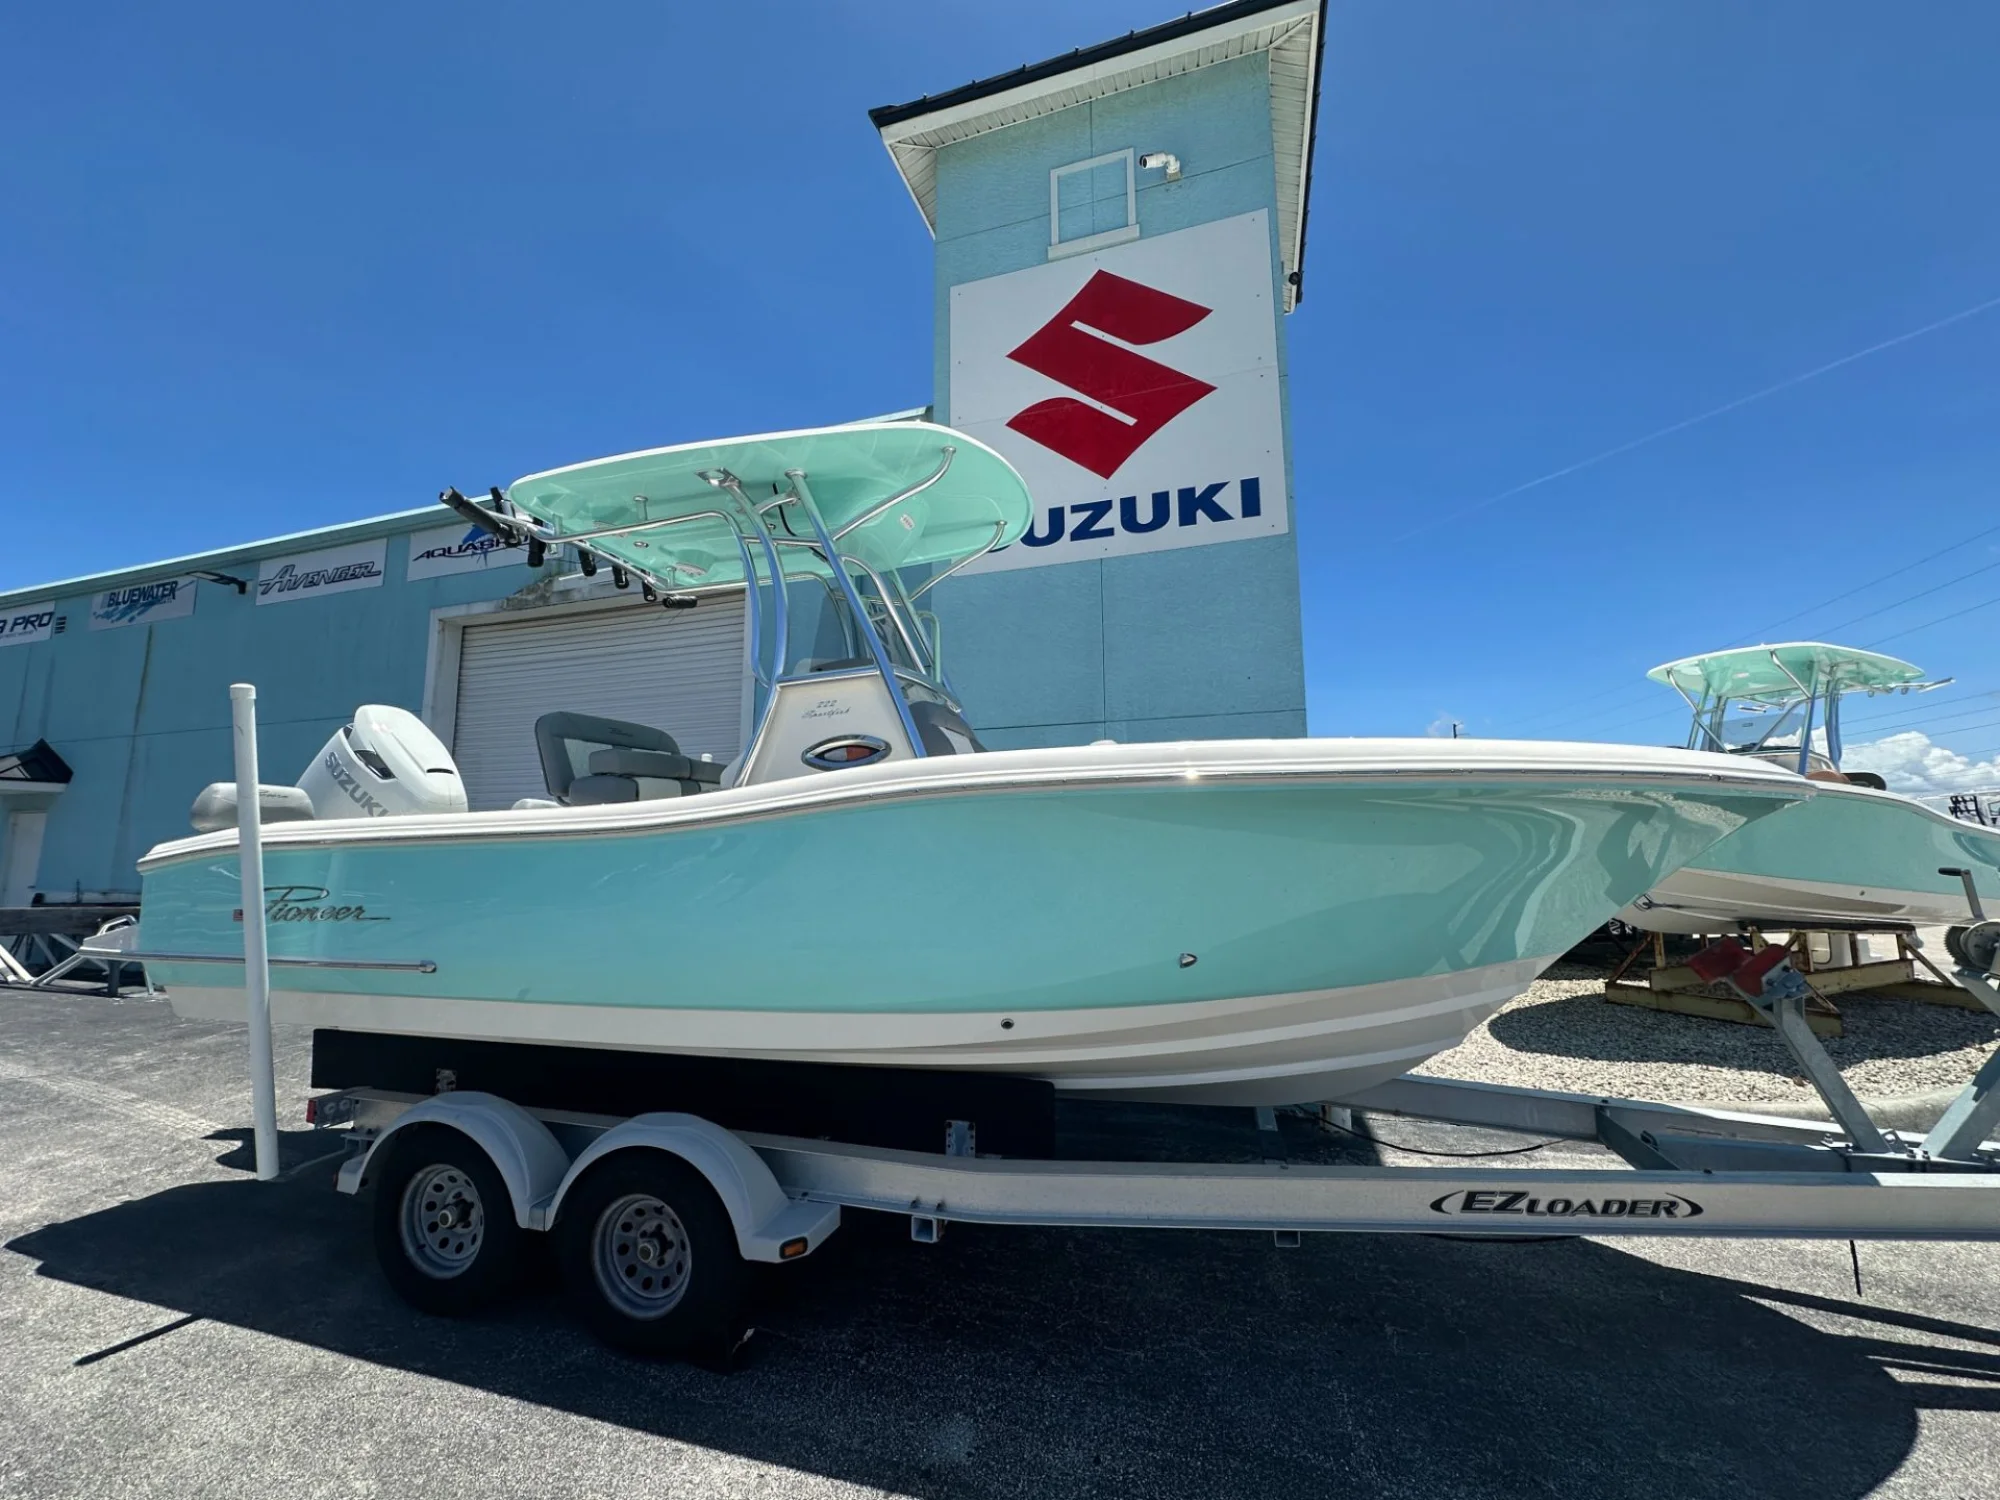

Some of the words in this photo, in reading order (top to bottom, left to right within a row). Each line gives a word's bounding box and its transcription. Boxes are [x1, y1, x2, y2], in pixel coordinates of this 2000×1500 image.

[988, 477, 1262, 552] UZUKI
[413, 535, 529, 561] AQUAS
[107, 581, 178, 607] BLUEWATER
[9, 611, 55, 631] PRO
[325, 751, 389, 817] SUZUKI
[264, 886, 391, 922] Pioneer
